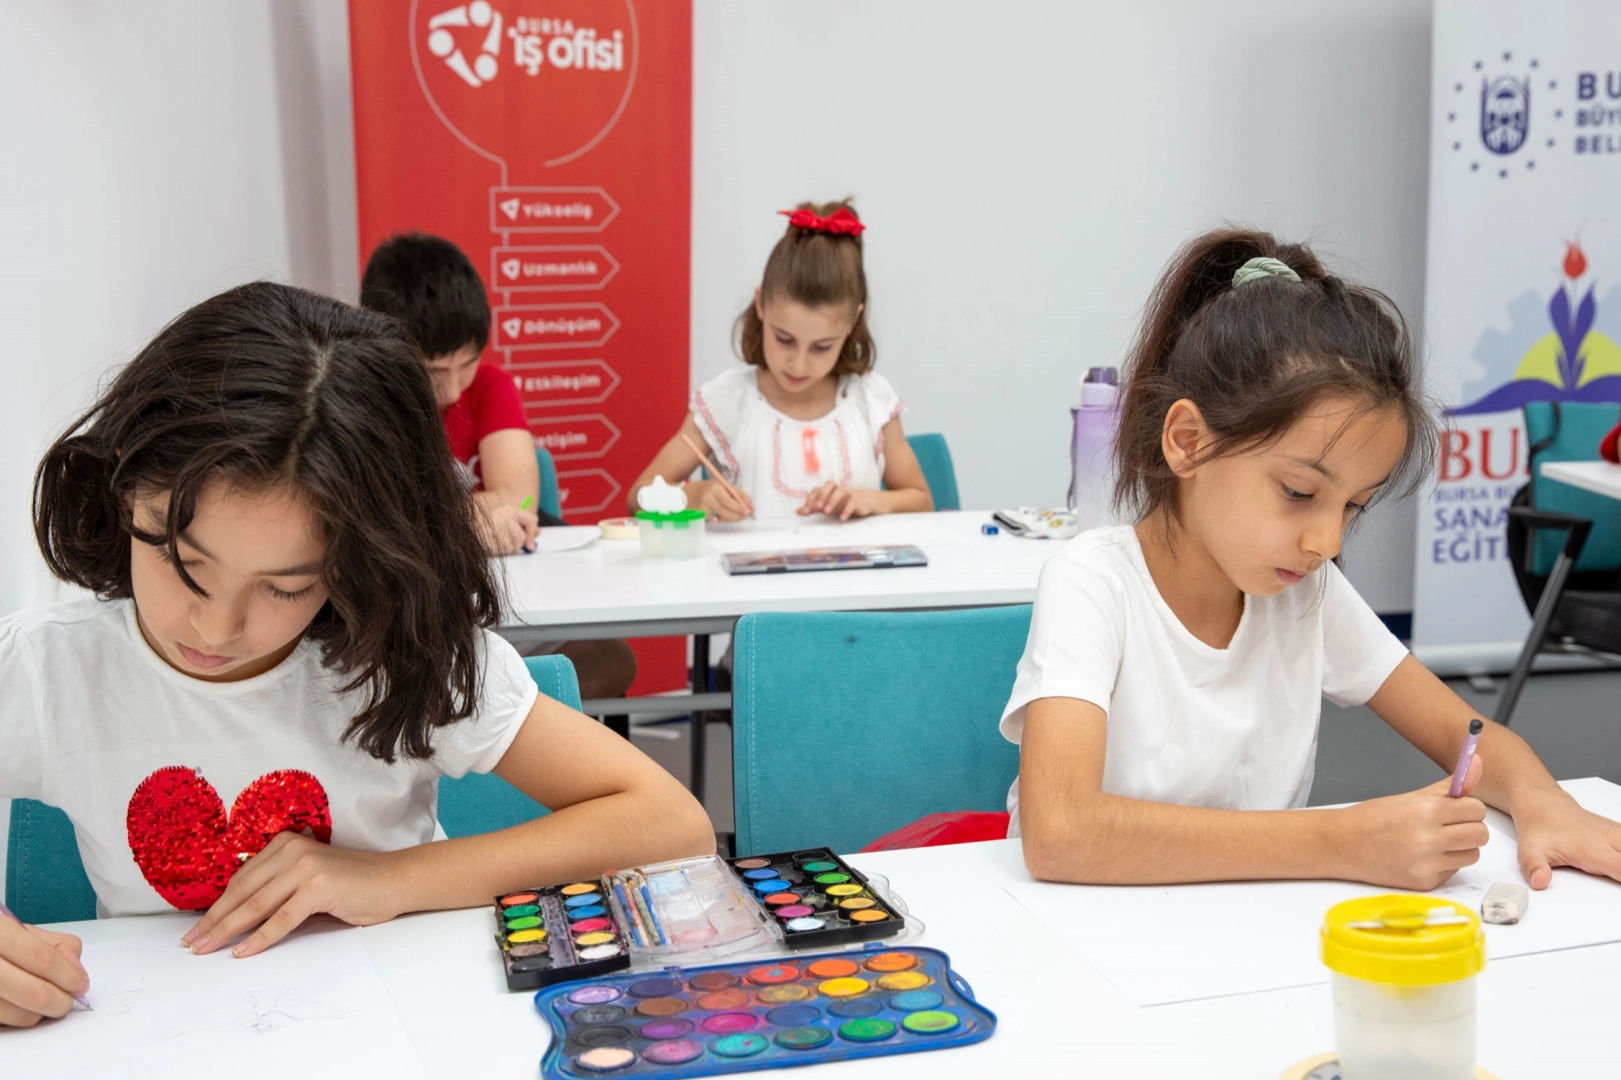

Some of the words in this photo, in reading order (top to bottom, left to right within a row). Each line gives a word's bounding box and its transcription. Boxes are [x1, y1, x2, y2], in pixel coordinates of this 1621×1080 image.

[517, 16, 575, 35] BURSA
[547, 27, 623, 71] ofisi
[1578, 71, 1621, 100] BU
[1577, 103, 1621, 127] BÜY
[1576, 135, 1621, 154] BEL
[522, 202, 593, 220] Yükseliş
[523, 260, 598, 277] Uzmanlık
[523, 317, 601, 336] Dönüşüm
[525, 374, 600, 392] Etkileşim
[1437, 427, 1531, 482] BU
[1432, 531, 1511, 564] EĞİT
